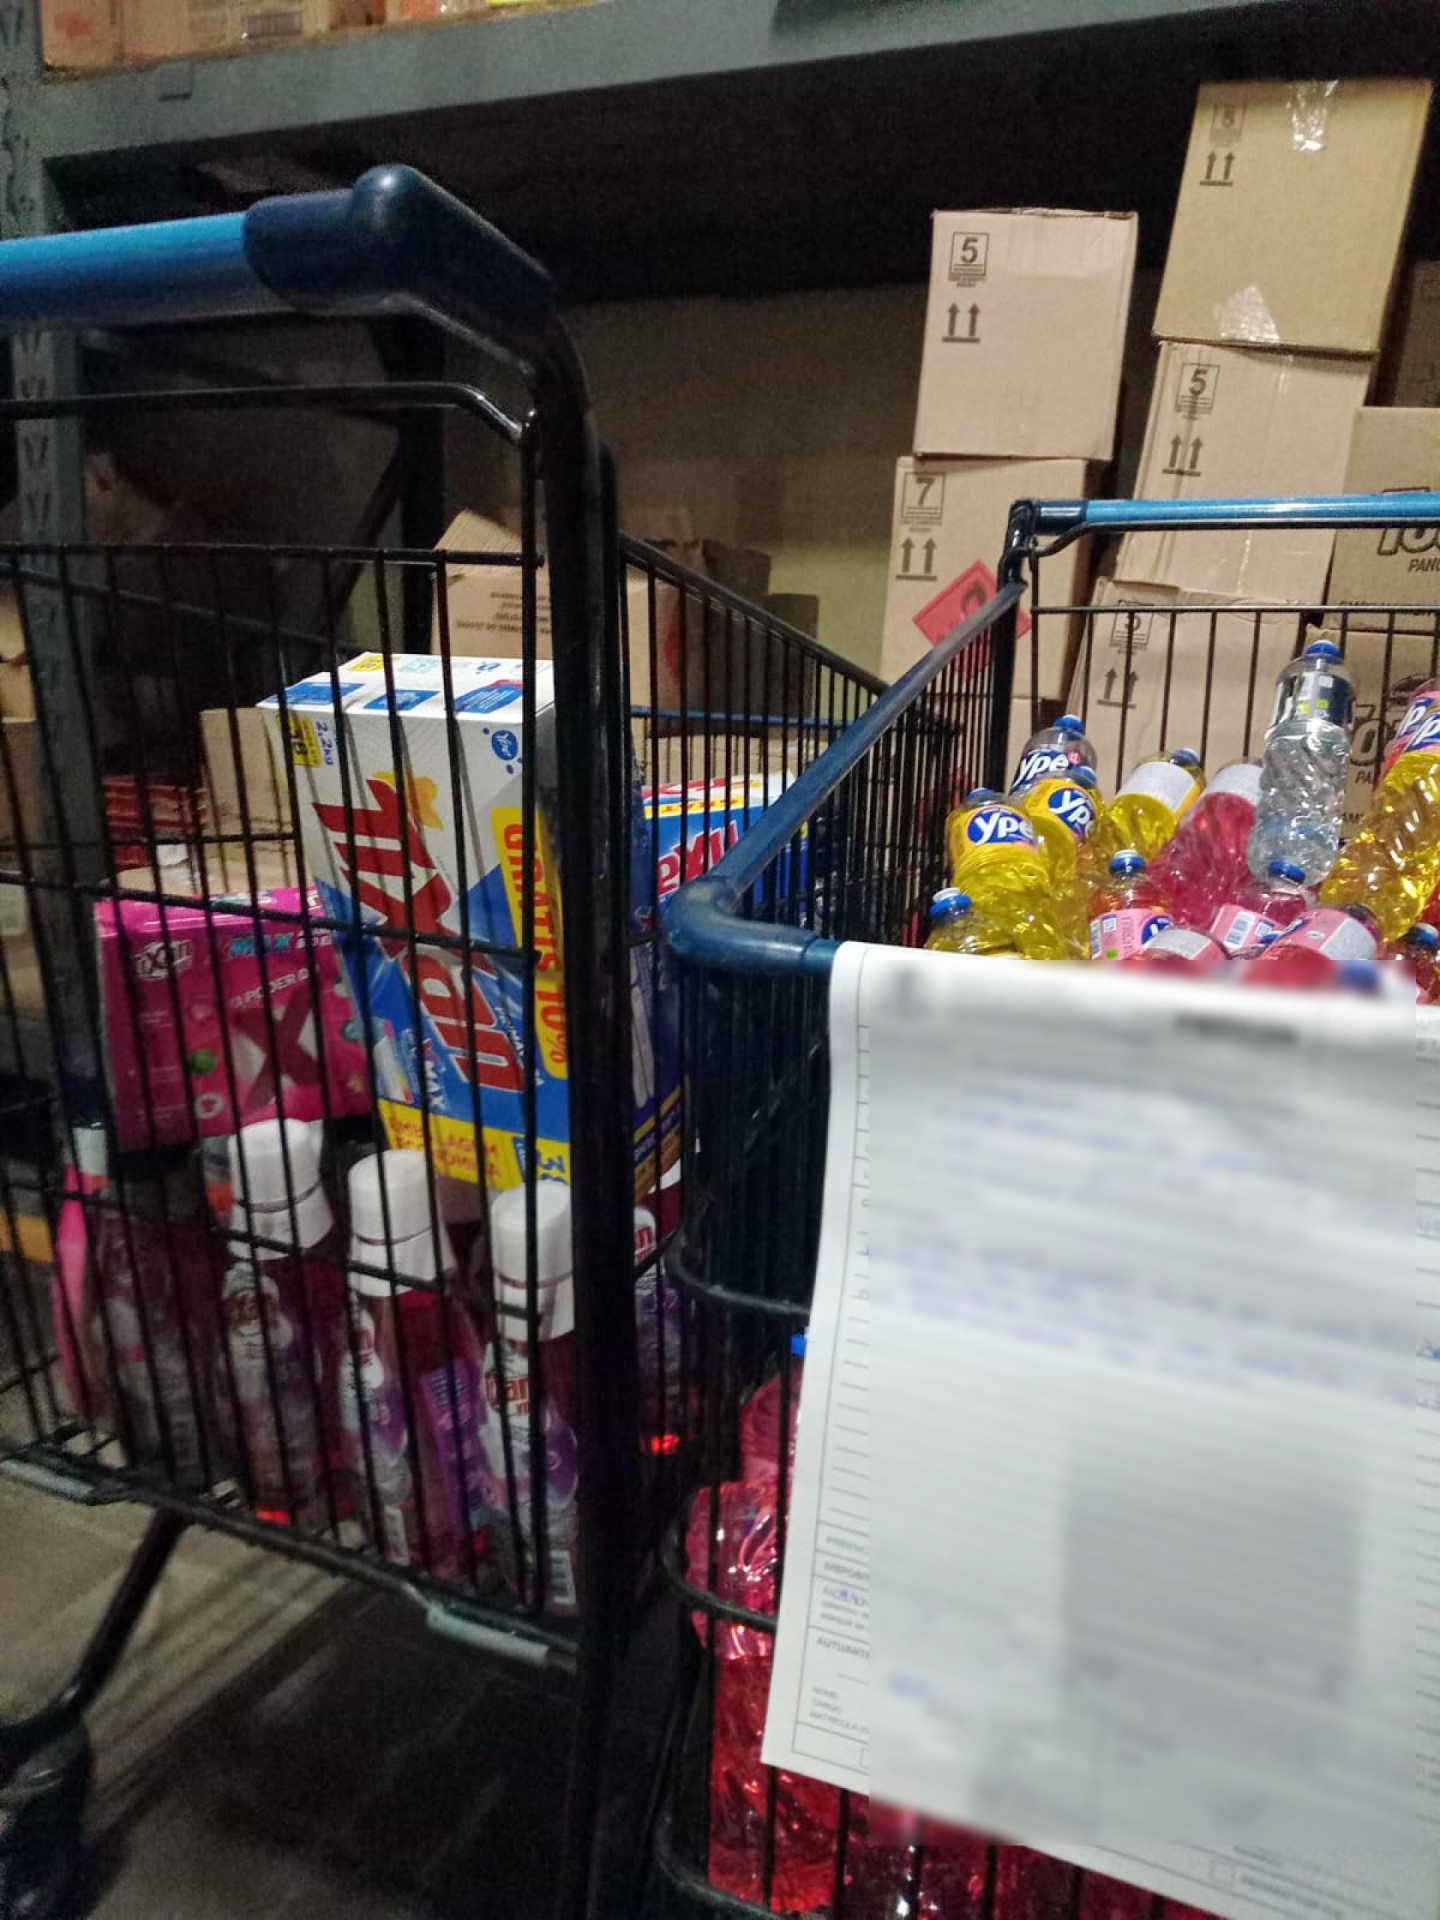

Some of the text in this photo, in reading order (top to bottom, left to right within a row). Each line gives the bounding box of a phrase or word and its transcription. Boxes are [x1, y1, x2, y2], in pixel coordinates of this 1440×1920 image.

[961, 236, 979, 264] 5
[1189, 368, 1208, 396] 5
[915, 477, 936, 506] 7
